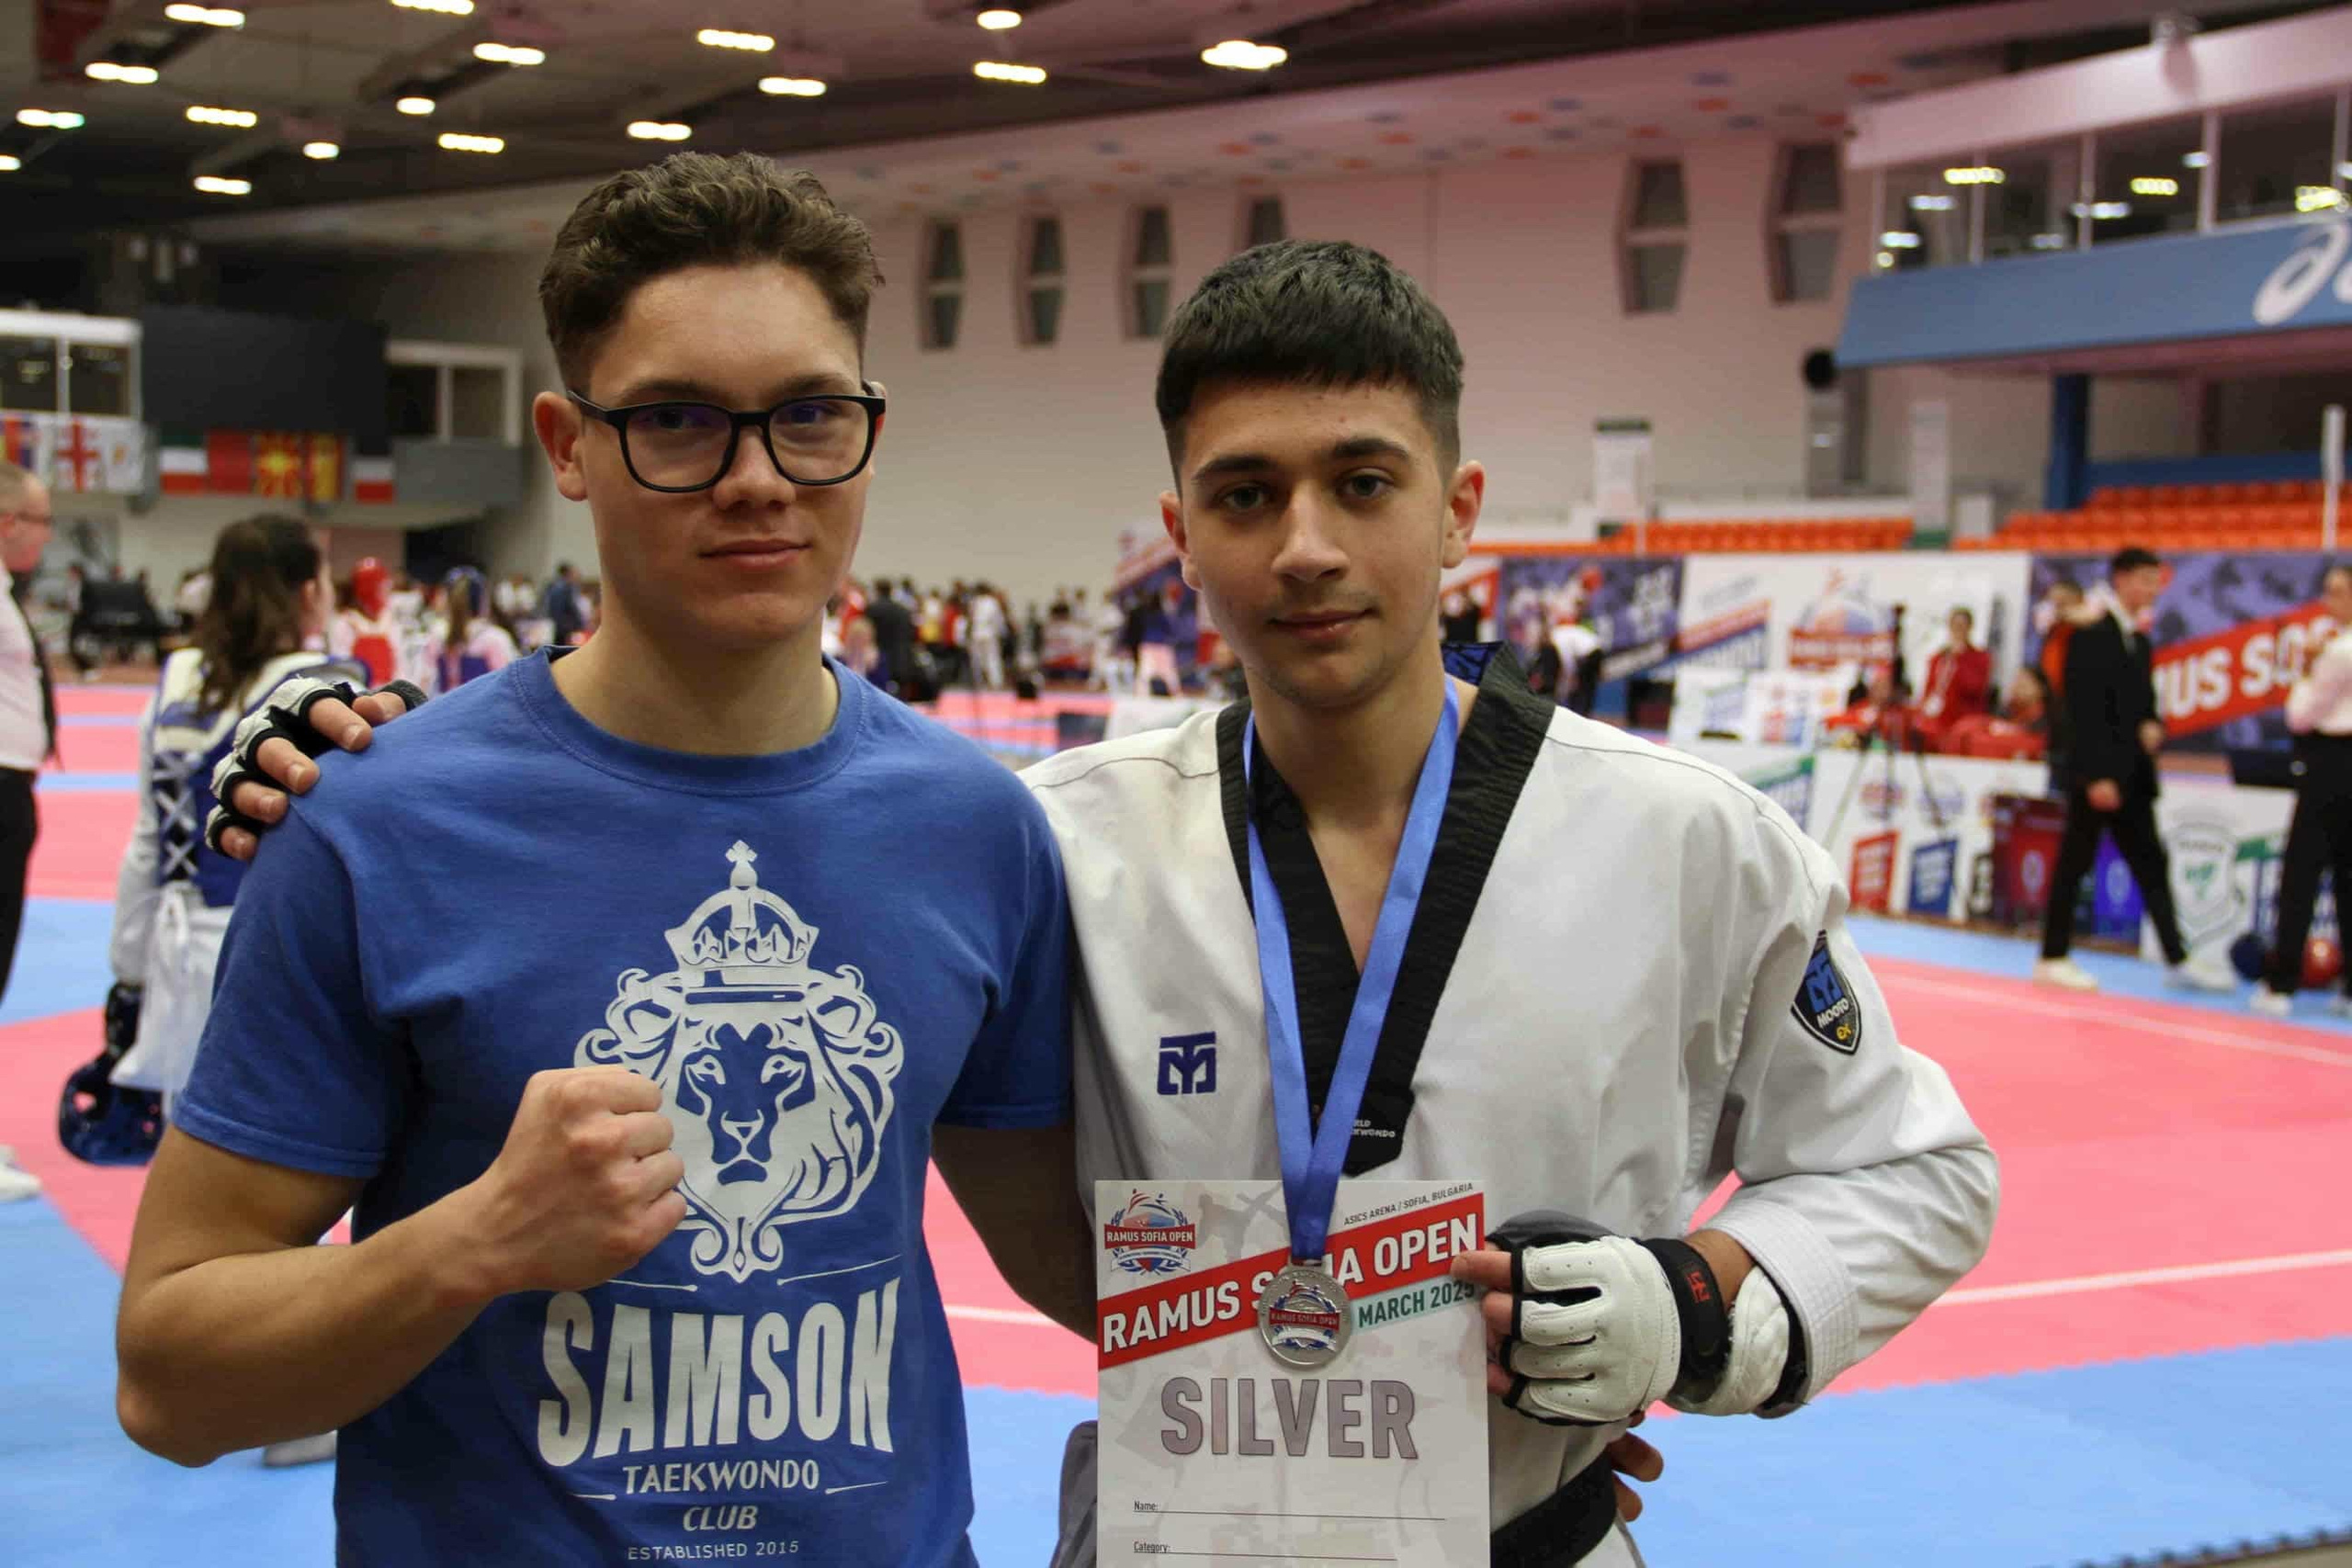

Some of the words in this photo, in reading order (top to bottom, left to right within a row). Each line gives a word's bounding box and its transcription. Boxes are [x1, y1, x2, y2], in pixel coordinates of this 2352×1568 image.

[1816, 998, 1850, 1029] MOOTO
[1344, 1212, 1368, 1225] ASICS
[1370, 1204, 1396, 1219] ARENA
[1431, 1182, 1474, 1201] BULGARIA
[1106, 1232, 1139, 1243] RAMUS
[1141, 1232, 1168, 1242] SOFIA
[1169, 1231, 1193, 1242] OPEN
[1103, 1280, 1241, 1353] RAMUS
[1374, 1213, 1478, 1277] OPEN
[1358, 1290, 1425, 1328] MARCH
[537, 1276, 901, 1467] SAMSON
[1160, 1376, 1419, 1459] SILVER
[622, 1459, 820, 1495] TAEKWONDO
[682, 1505, 759, 1532] CLUB
[1133, 1500, 1159, 1512] Name:
[628, 1542, 748, 1561] ESTABLISHED
[755, 1540, 800, 1557] 2015
[1133, 1541, 1171, 1555] Category:
